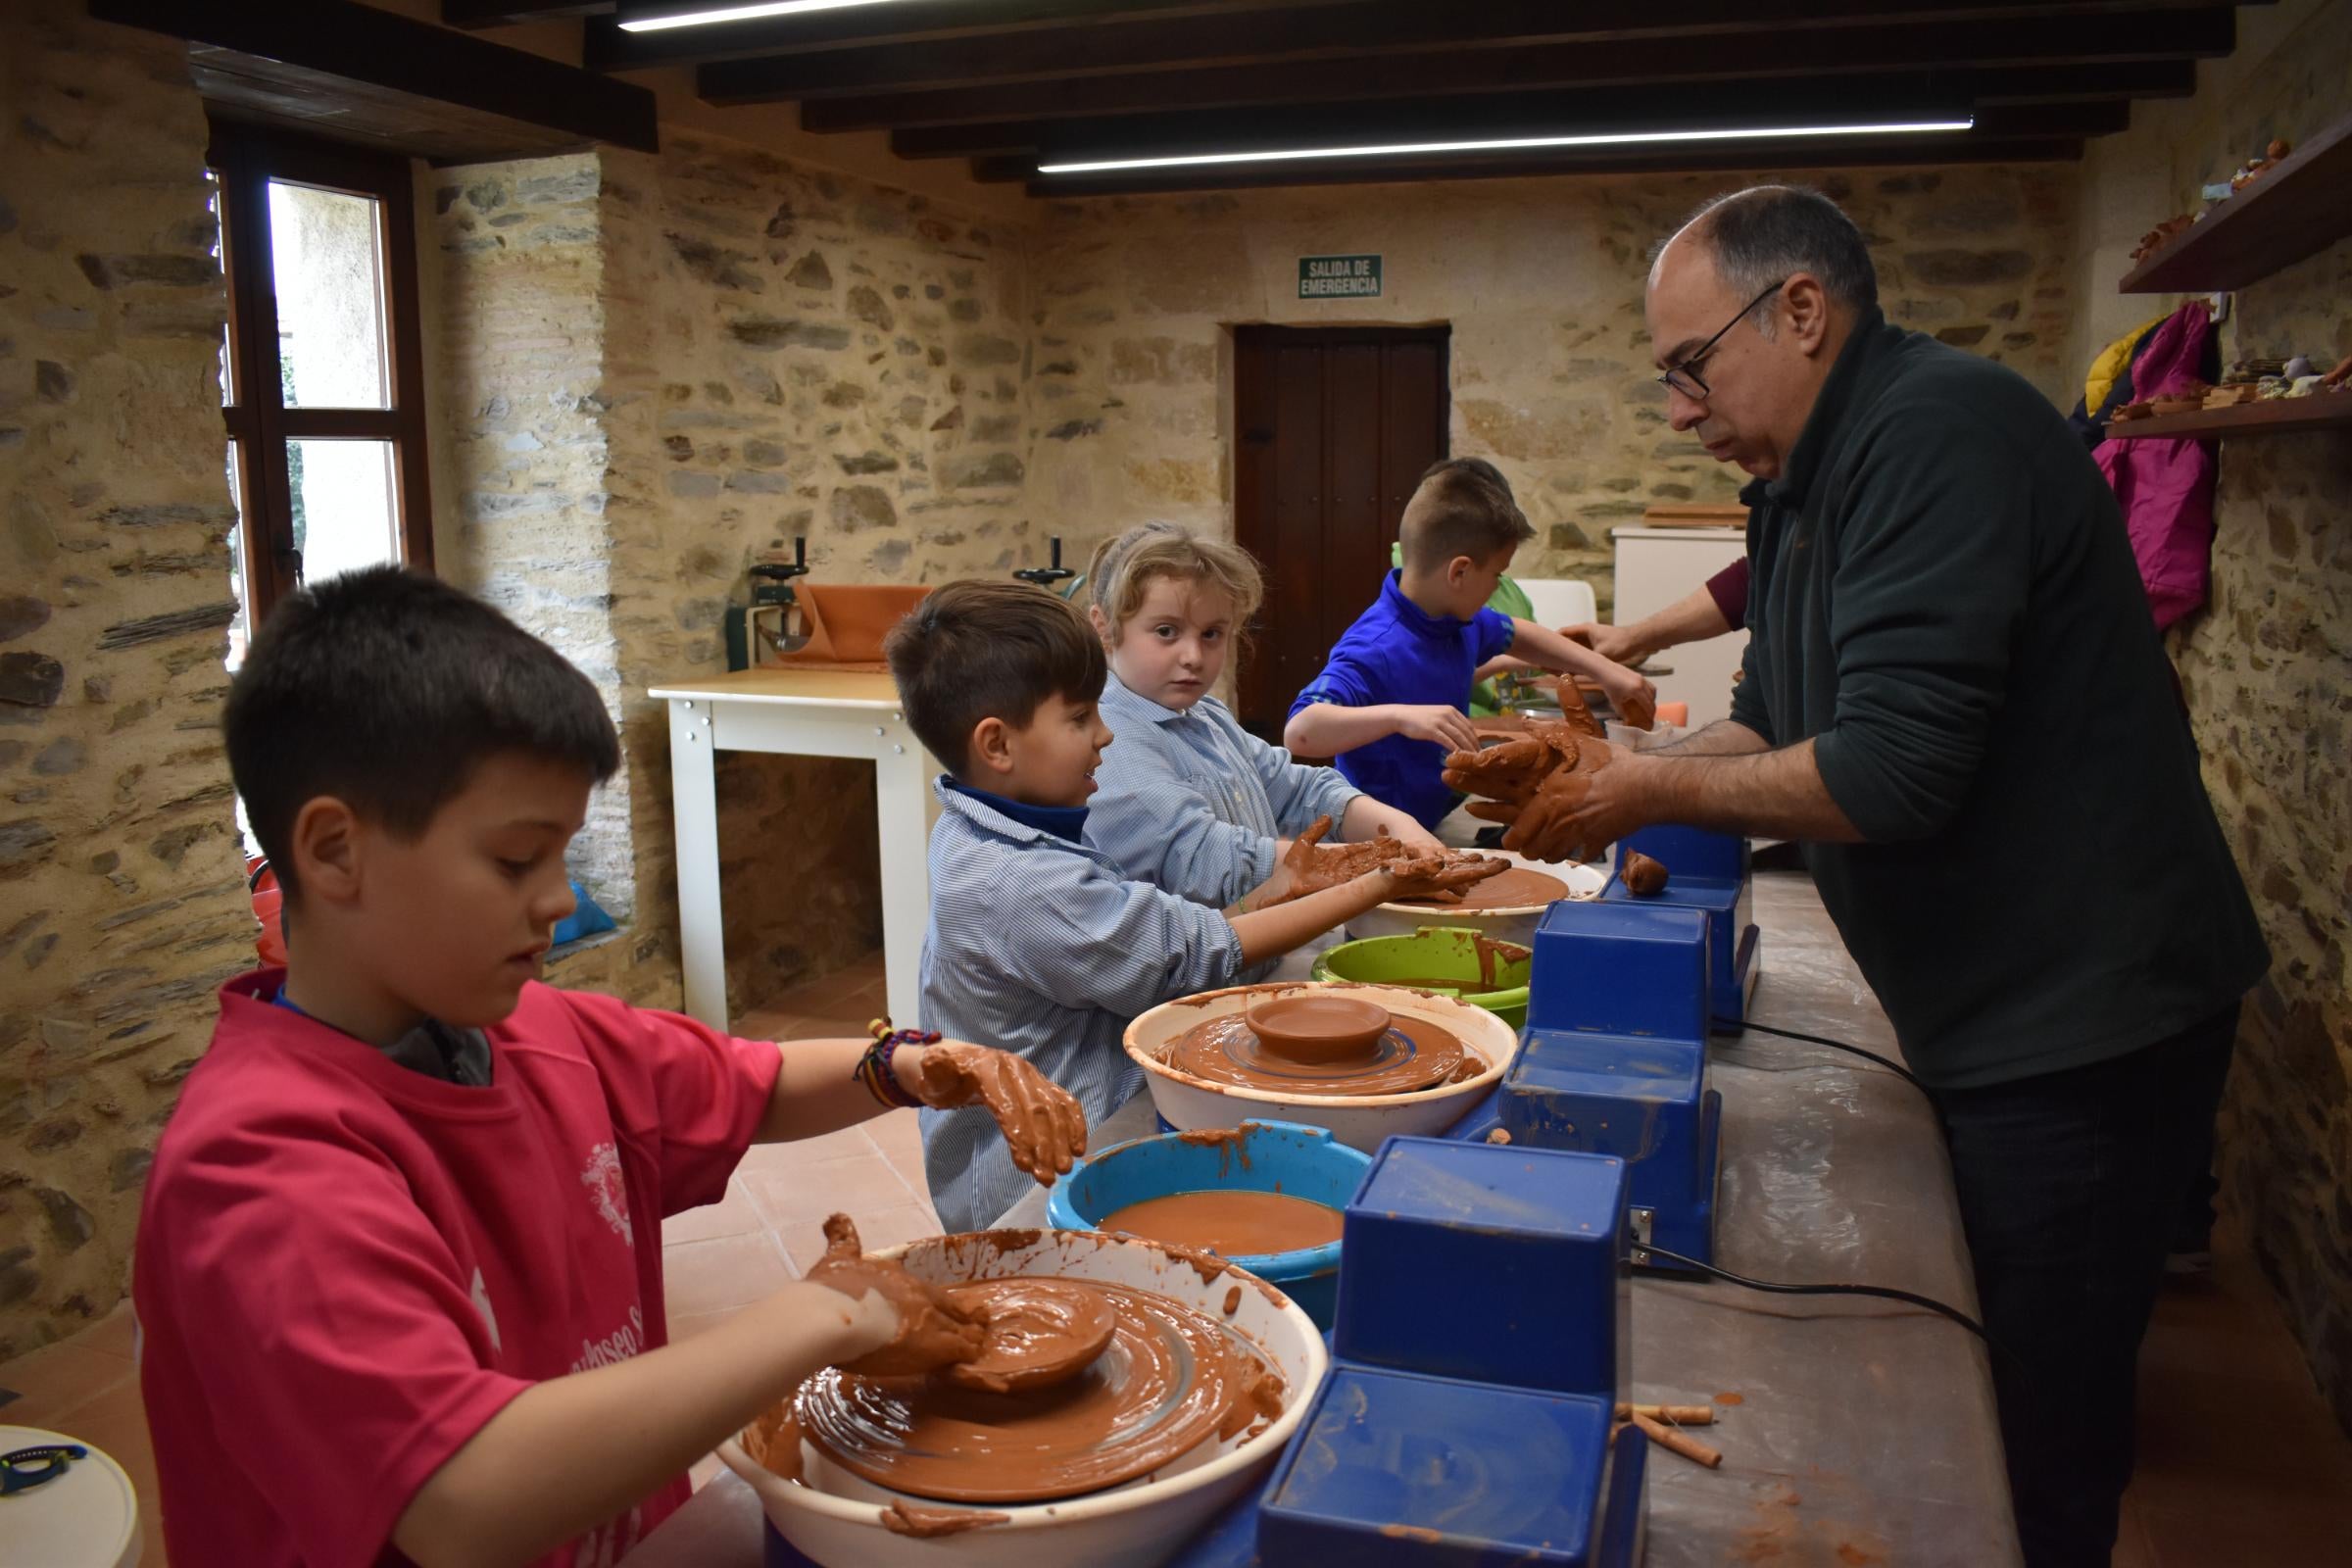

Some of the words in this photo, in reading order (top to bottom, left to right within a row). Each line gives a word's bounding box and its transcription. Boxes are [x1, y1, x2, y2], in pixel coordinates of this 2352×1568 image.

[1309, 261, 1350, 276] SALIDA
[1354, 260, 1370, 275] DE
[1301, 276, 1378, 294] EMERGENCIA
